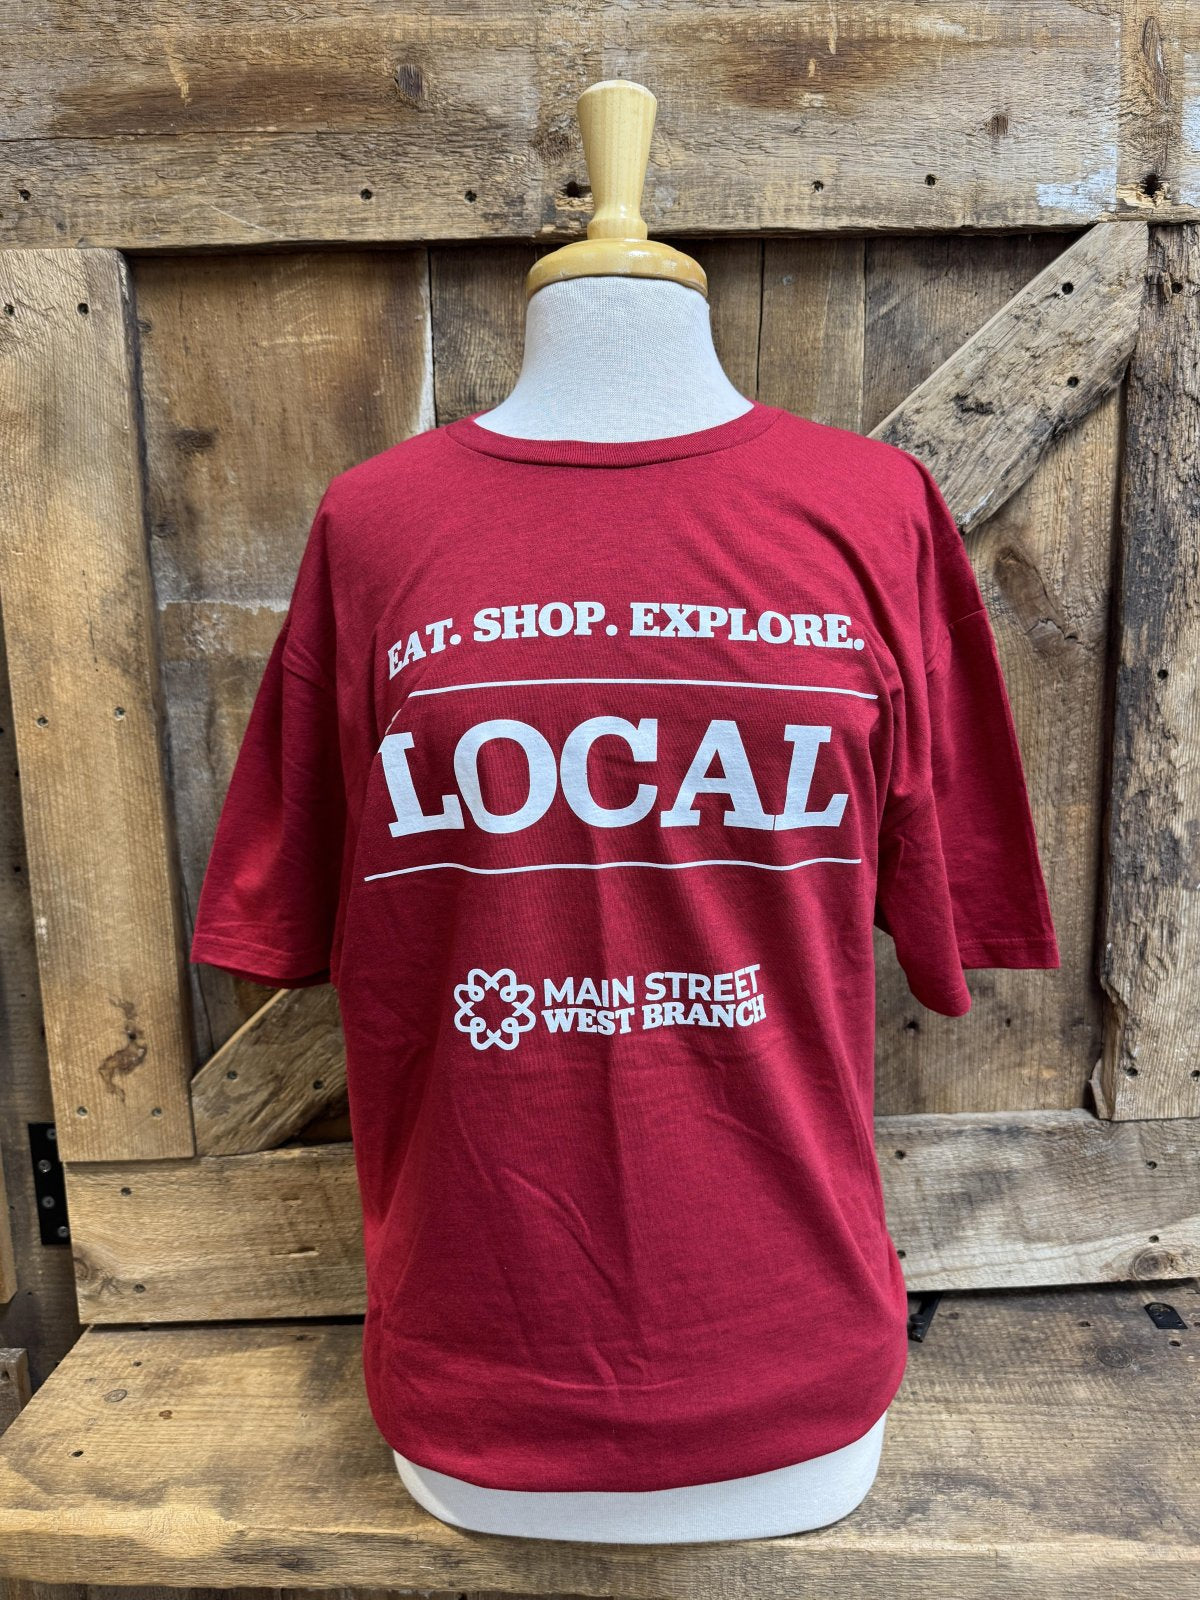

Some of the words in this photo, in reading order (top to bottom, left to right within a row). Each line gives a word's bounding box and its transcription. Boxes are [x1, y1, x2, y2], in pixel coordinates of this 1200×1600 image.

[387, 617, 462, 681] EAT.
[473, 601, 619, 643] SHOP.
[629, 601, 865, 651] EXPLORE.
[378, 716, 849, 838] LOCAL
[540, 1006, 636, 1036] WEST
[641, 993, 767, 1031] BRANCH
[543, 975, 635, 1008] MAIN
[644, 963, 761, 1002] STREET
